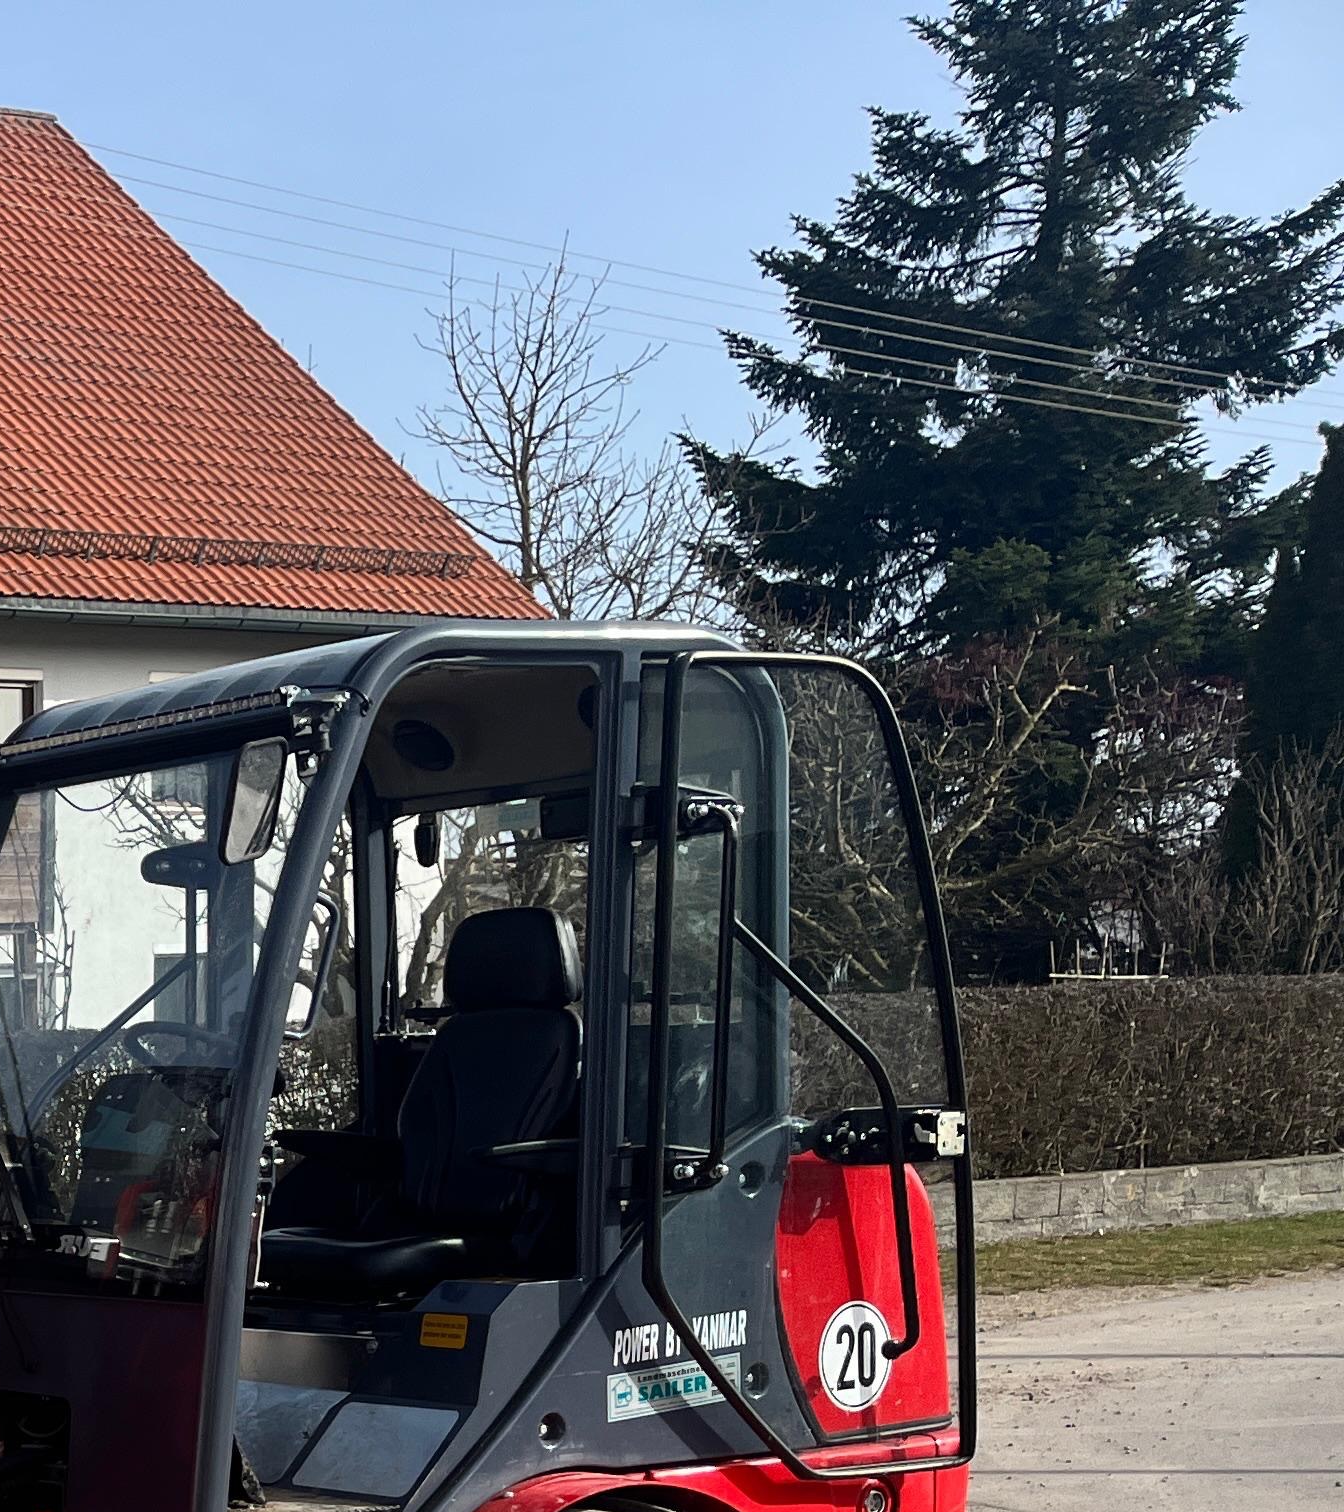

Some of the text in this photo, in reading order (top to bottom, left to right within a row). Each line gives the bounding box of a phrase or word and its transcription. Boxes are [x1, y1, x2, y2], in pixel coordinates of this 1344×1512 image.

[613, 1323, 659, 1367] POWER
[692, 1309, 747, 1351] YANMAR
[836, 1321, 876, 1391] 20
[638, 1375, 707, 1401] SAILER
